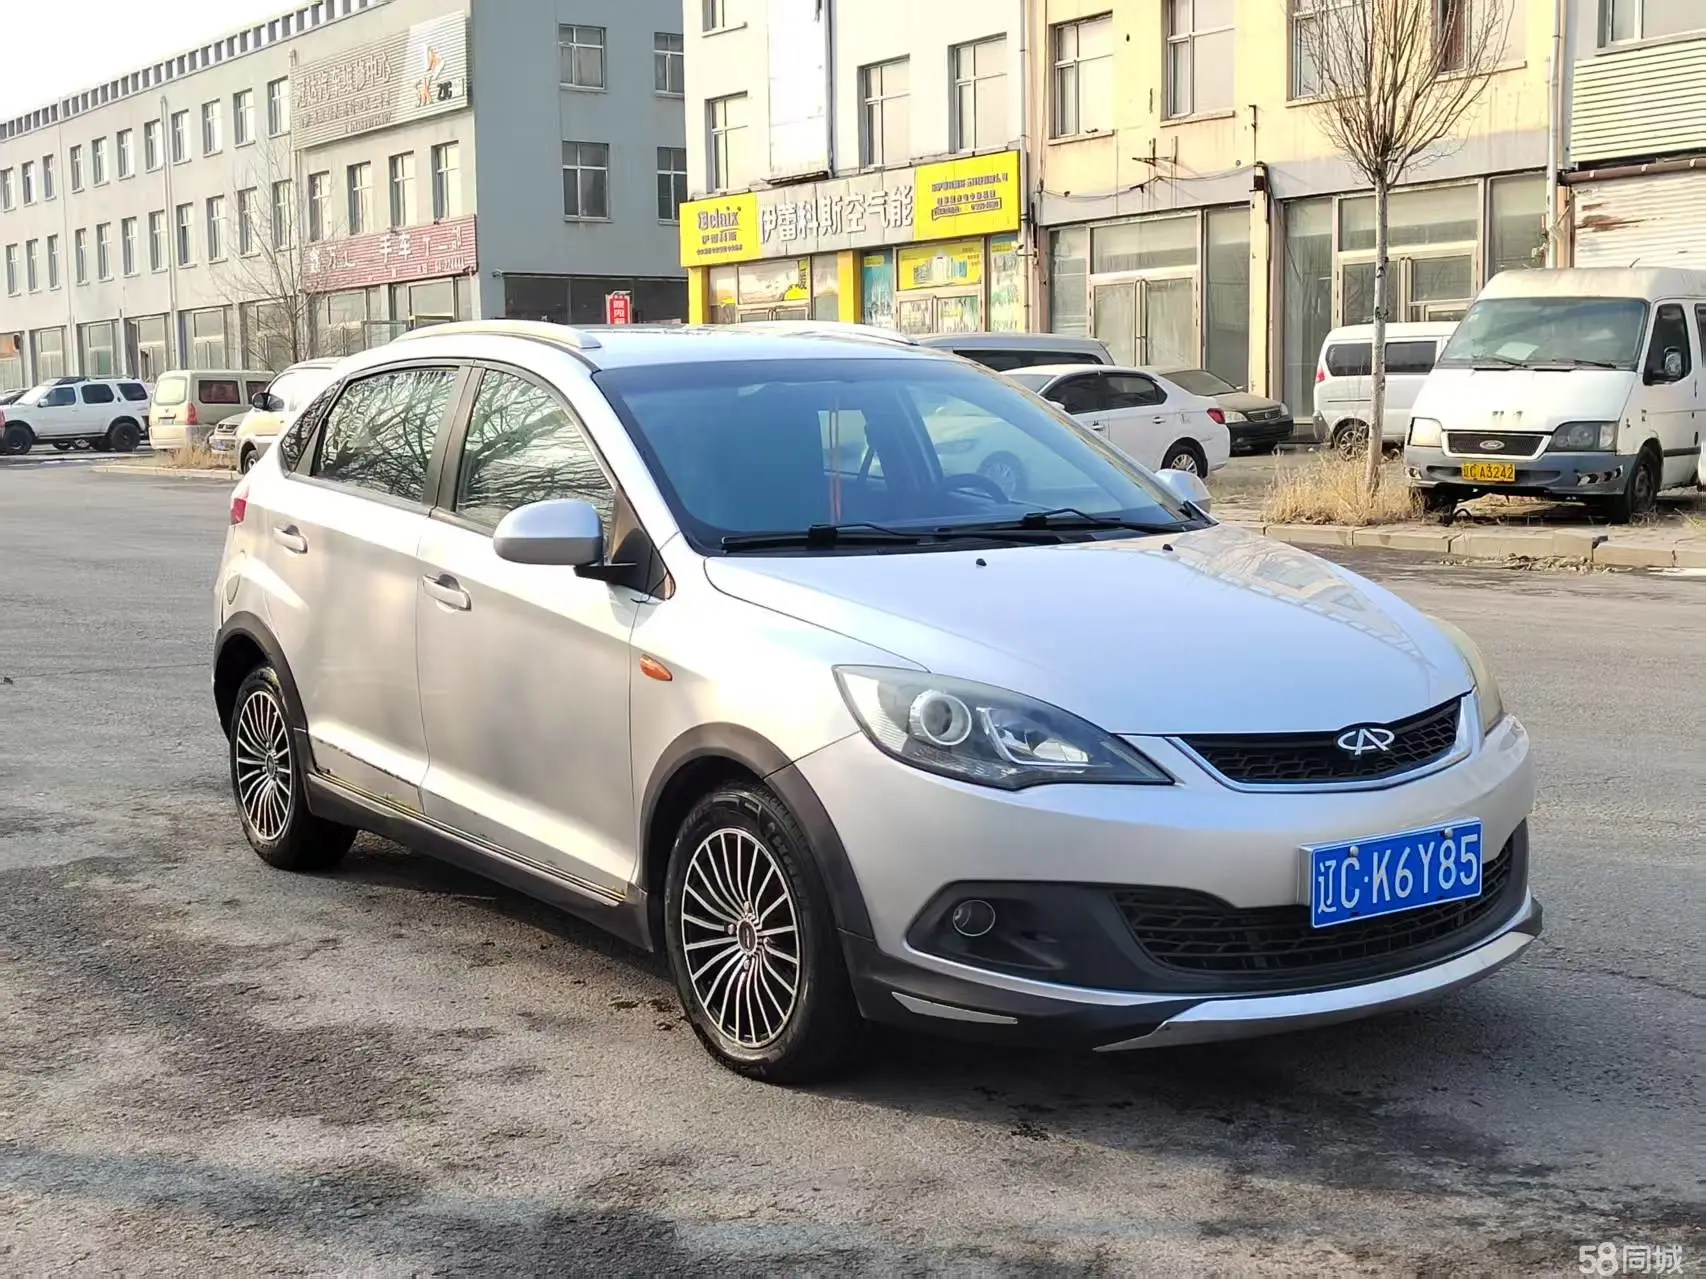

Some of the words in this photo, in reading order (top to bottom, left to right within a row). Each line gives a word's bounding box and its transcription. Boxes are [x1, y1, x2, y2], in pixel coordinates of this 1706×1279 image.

[761, 186, 913, 244] 伊蕾科斯空气能
